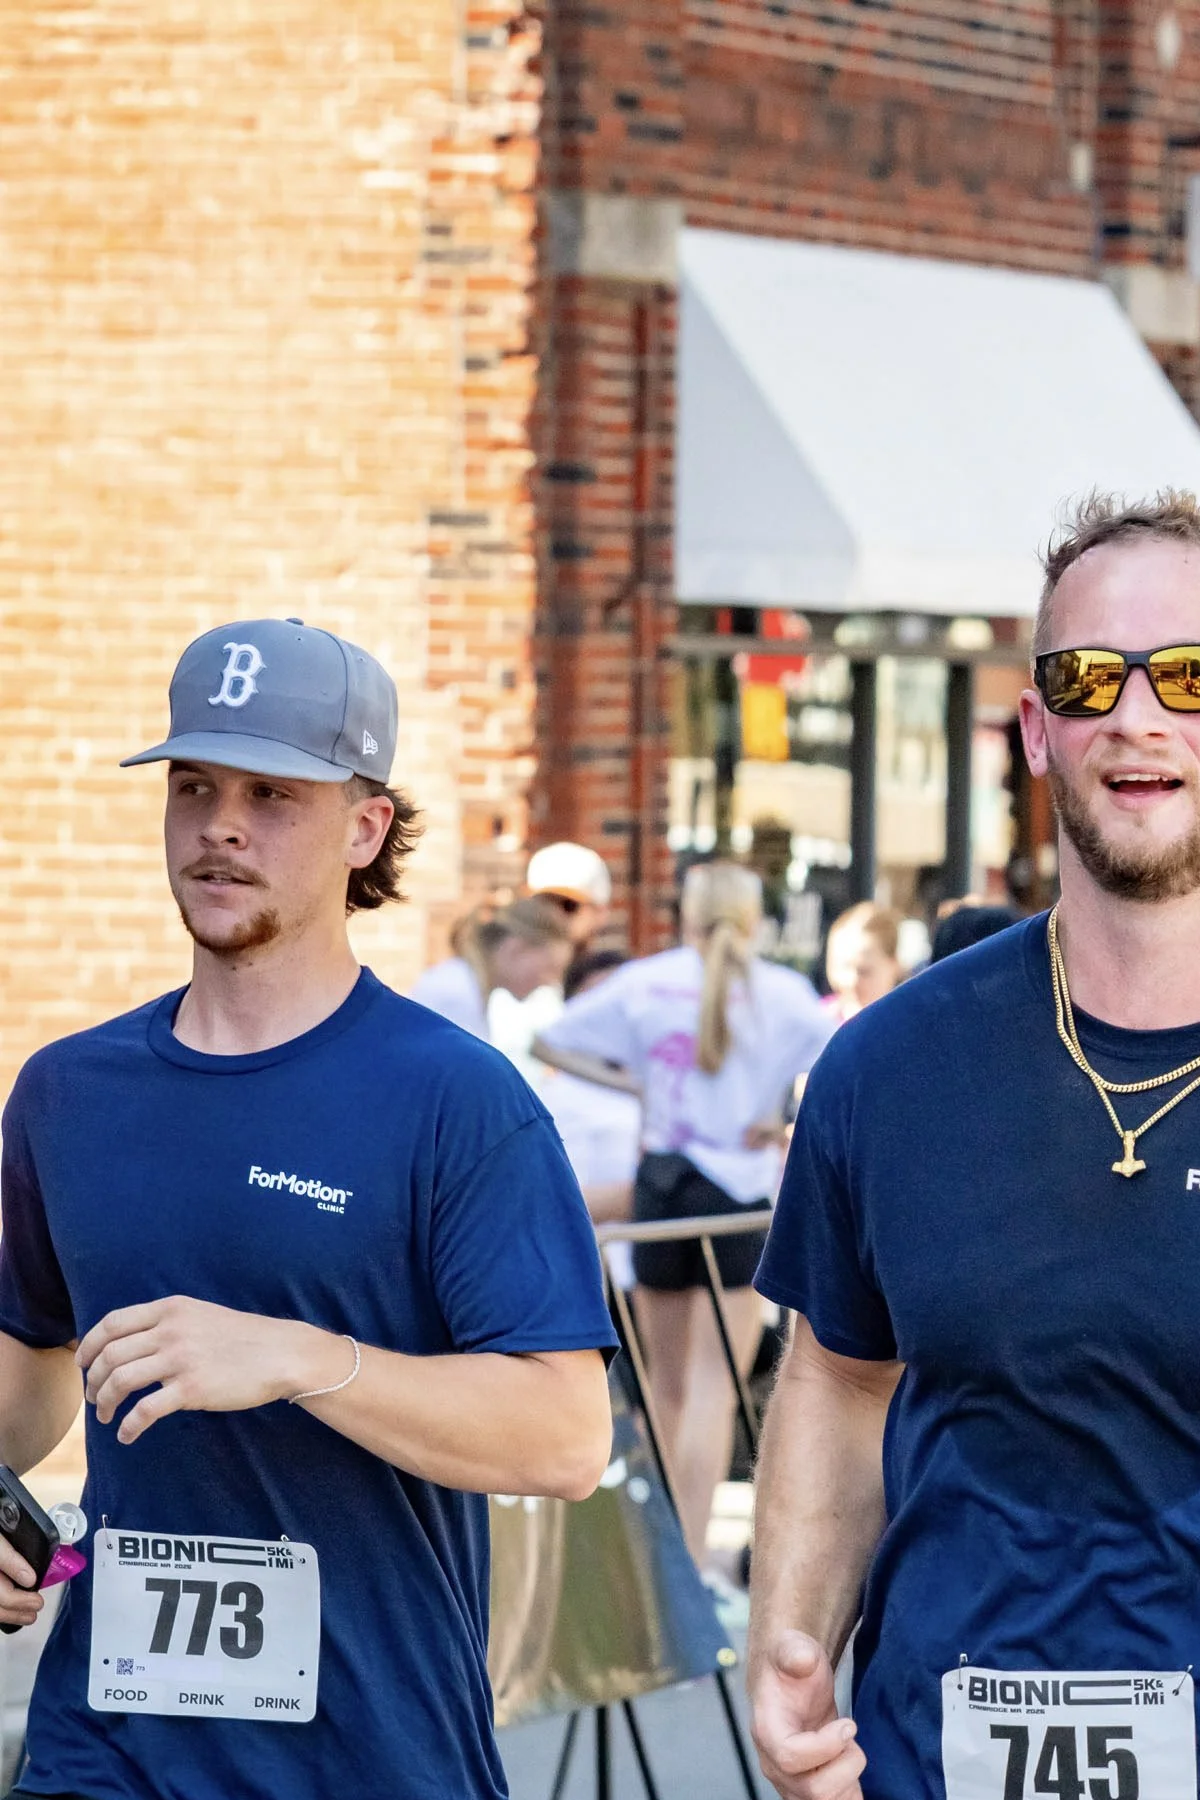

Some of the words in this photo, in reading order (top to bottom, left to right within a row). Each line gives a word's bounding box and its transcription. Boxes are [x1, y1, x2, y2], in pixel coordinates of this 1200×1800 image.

[208, 641, 268, 707] B
[317, 1202, 345, 1214] CLINIC
[118, 1536, 267, 1567] BIONIC
[145, 1577, 264, 1659] 773
[104, 1689, 148, 1702] FOOD
[178, 1692, 225, 1706] DRINK
[254, 1697, 301, 1710] DRINK
[968, 1676, 1133, 1706] BIONIC
